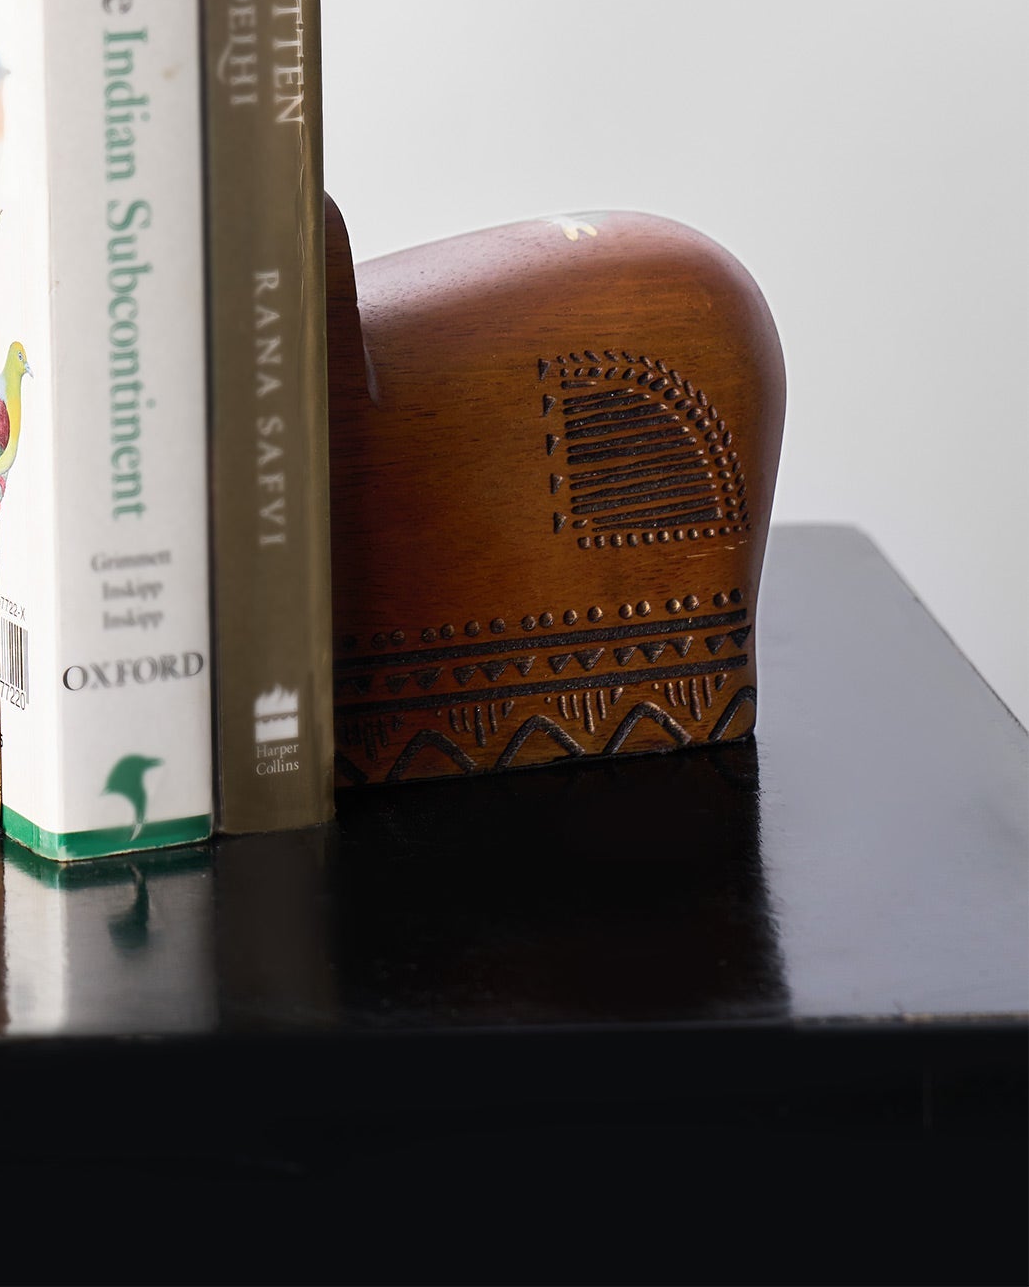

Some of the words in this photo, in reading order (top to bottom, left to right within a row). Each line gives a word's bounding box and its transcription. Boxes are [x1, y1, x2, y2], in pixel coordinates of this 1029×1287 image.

[102, 27, 150, 181] Indian
[107, 199, 155, 519] Subcontinent
[255, 269, 282, 398] RANA
[257, 415, 286, 546] SAFVI
[62, 651, 204, 691] OXFORD
[256, 743, 299, 759] Harper
[256, 759, 299, 776] Collins
